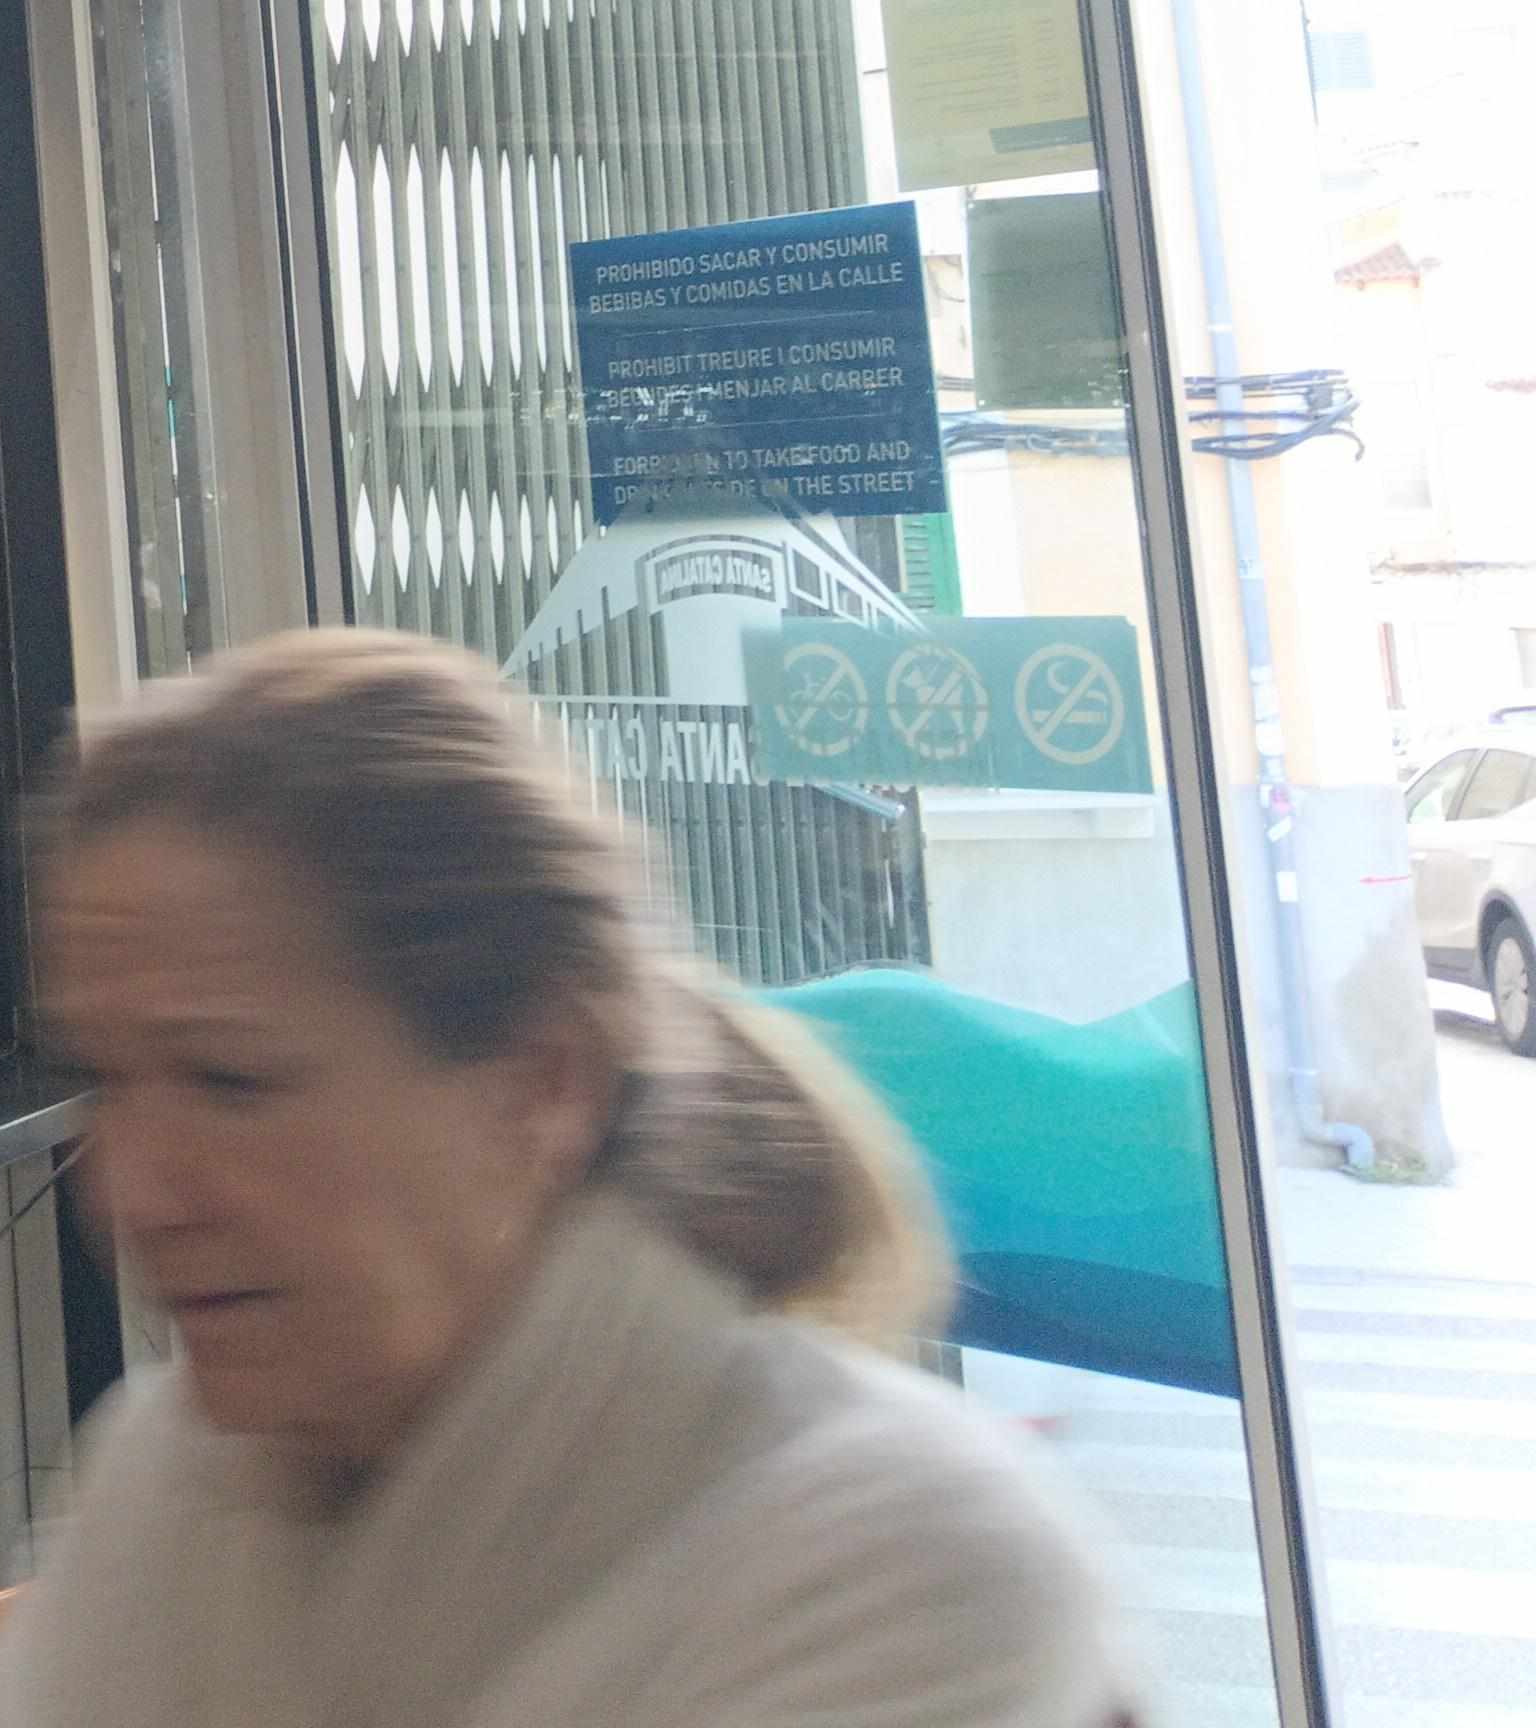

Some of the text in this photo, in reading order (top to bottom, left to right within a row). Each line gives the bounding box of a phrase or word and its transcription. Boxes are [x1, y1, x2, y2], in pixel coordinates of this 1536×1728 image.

[595, 232, 890, 285] PROHIBIDO SACAR Y CONSUMIR
[670, 288, 682, 307] Y
[686, 276, 771, 305] COMIDAS
[776, 273, 803, 293] EN
[809, 270, 835, 292] LA
[838, 261, 905, 288] CALLE
[607, 352, 692, 381] PROHIBIT
[695, 346, 774, 373] TREURE
[787, 336, 897, 365] CONSUMIR
[707, 376, 787, 401] MENJAR
[791, 375, 812, 393] AL
[752, 446, 803, 468] TAKE
[808, 443, 861, 465] FOOD
[866, 440, 912, 462] AND
[794, 474, 836, 497] THE
[837, 470, 915, 494] STREET
